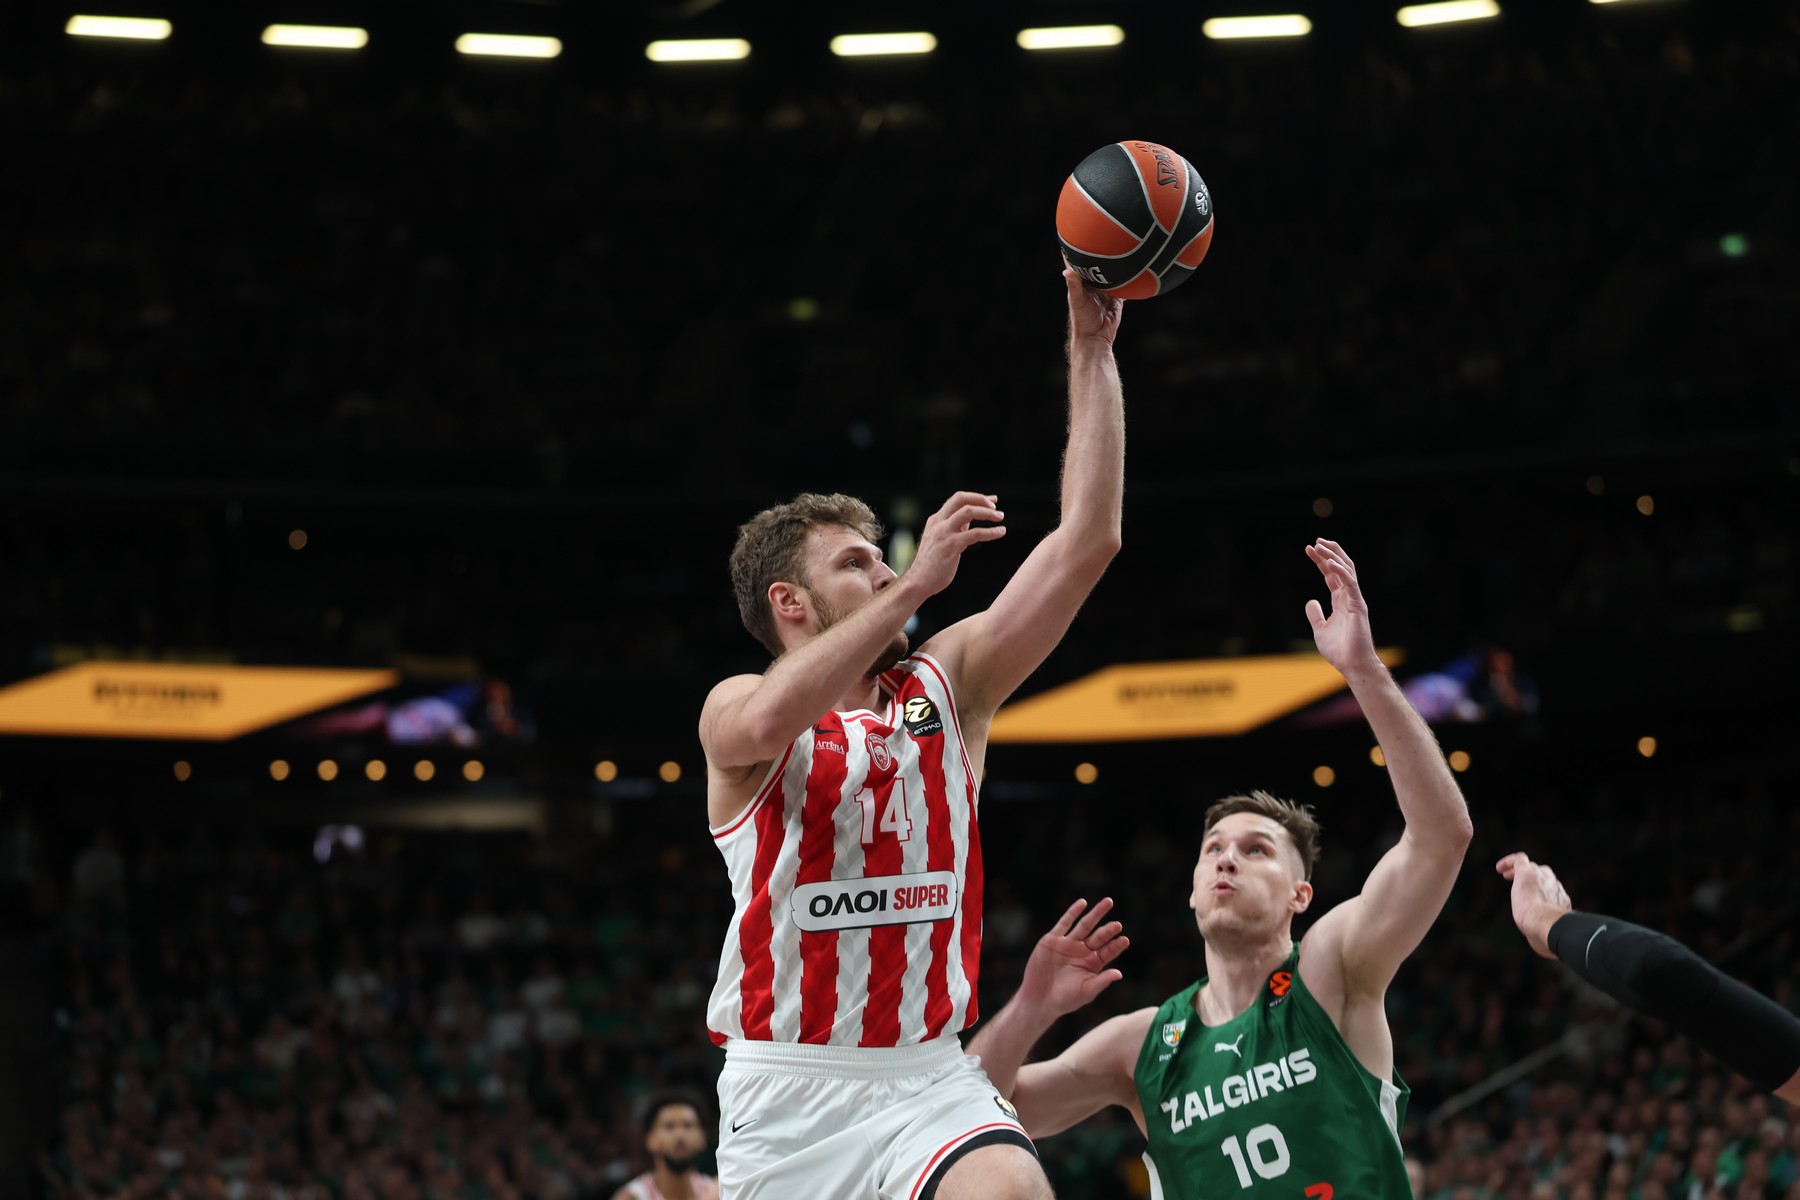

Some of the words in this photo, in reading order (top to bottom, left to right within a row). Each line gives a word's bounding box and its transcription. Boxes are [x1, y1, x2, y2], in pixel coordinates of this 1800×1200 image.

[914, 723, 941, 735] ETIHAD
[854, 778, 912, 844] 14
[893, 884, 949, 910] SUPER
[1161, 1048, 1317, 1134] ZALGIRIS
[1221, 1123, 1290, 1189] 10
